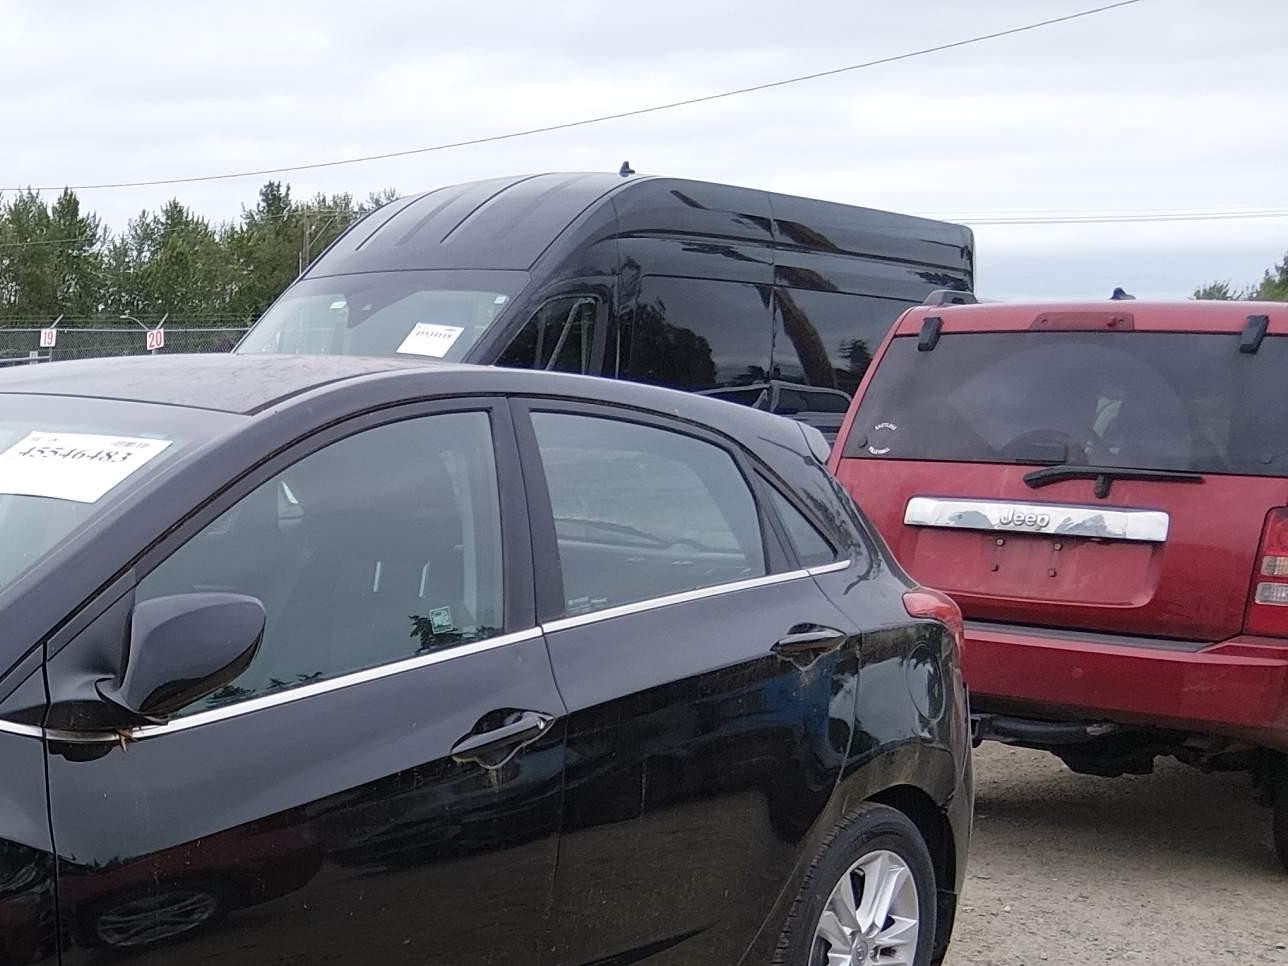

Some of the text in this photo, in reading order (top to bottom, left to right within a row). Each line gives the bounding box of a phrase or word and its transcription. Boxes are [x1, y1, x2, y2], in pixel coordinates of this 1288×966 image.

[43, 331, 53, 346] 19
[148, 331, 162, 348] 20
[18, 446, 132, 463] 45546483
[999, 508, 1050, 531] Jeep
